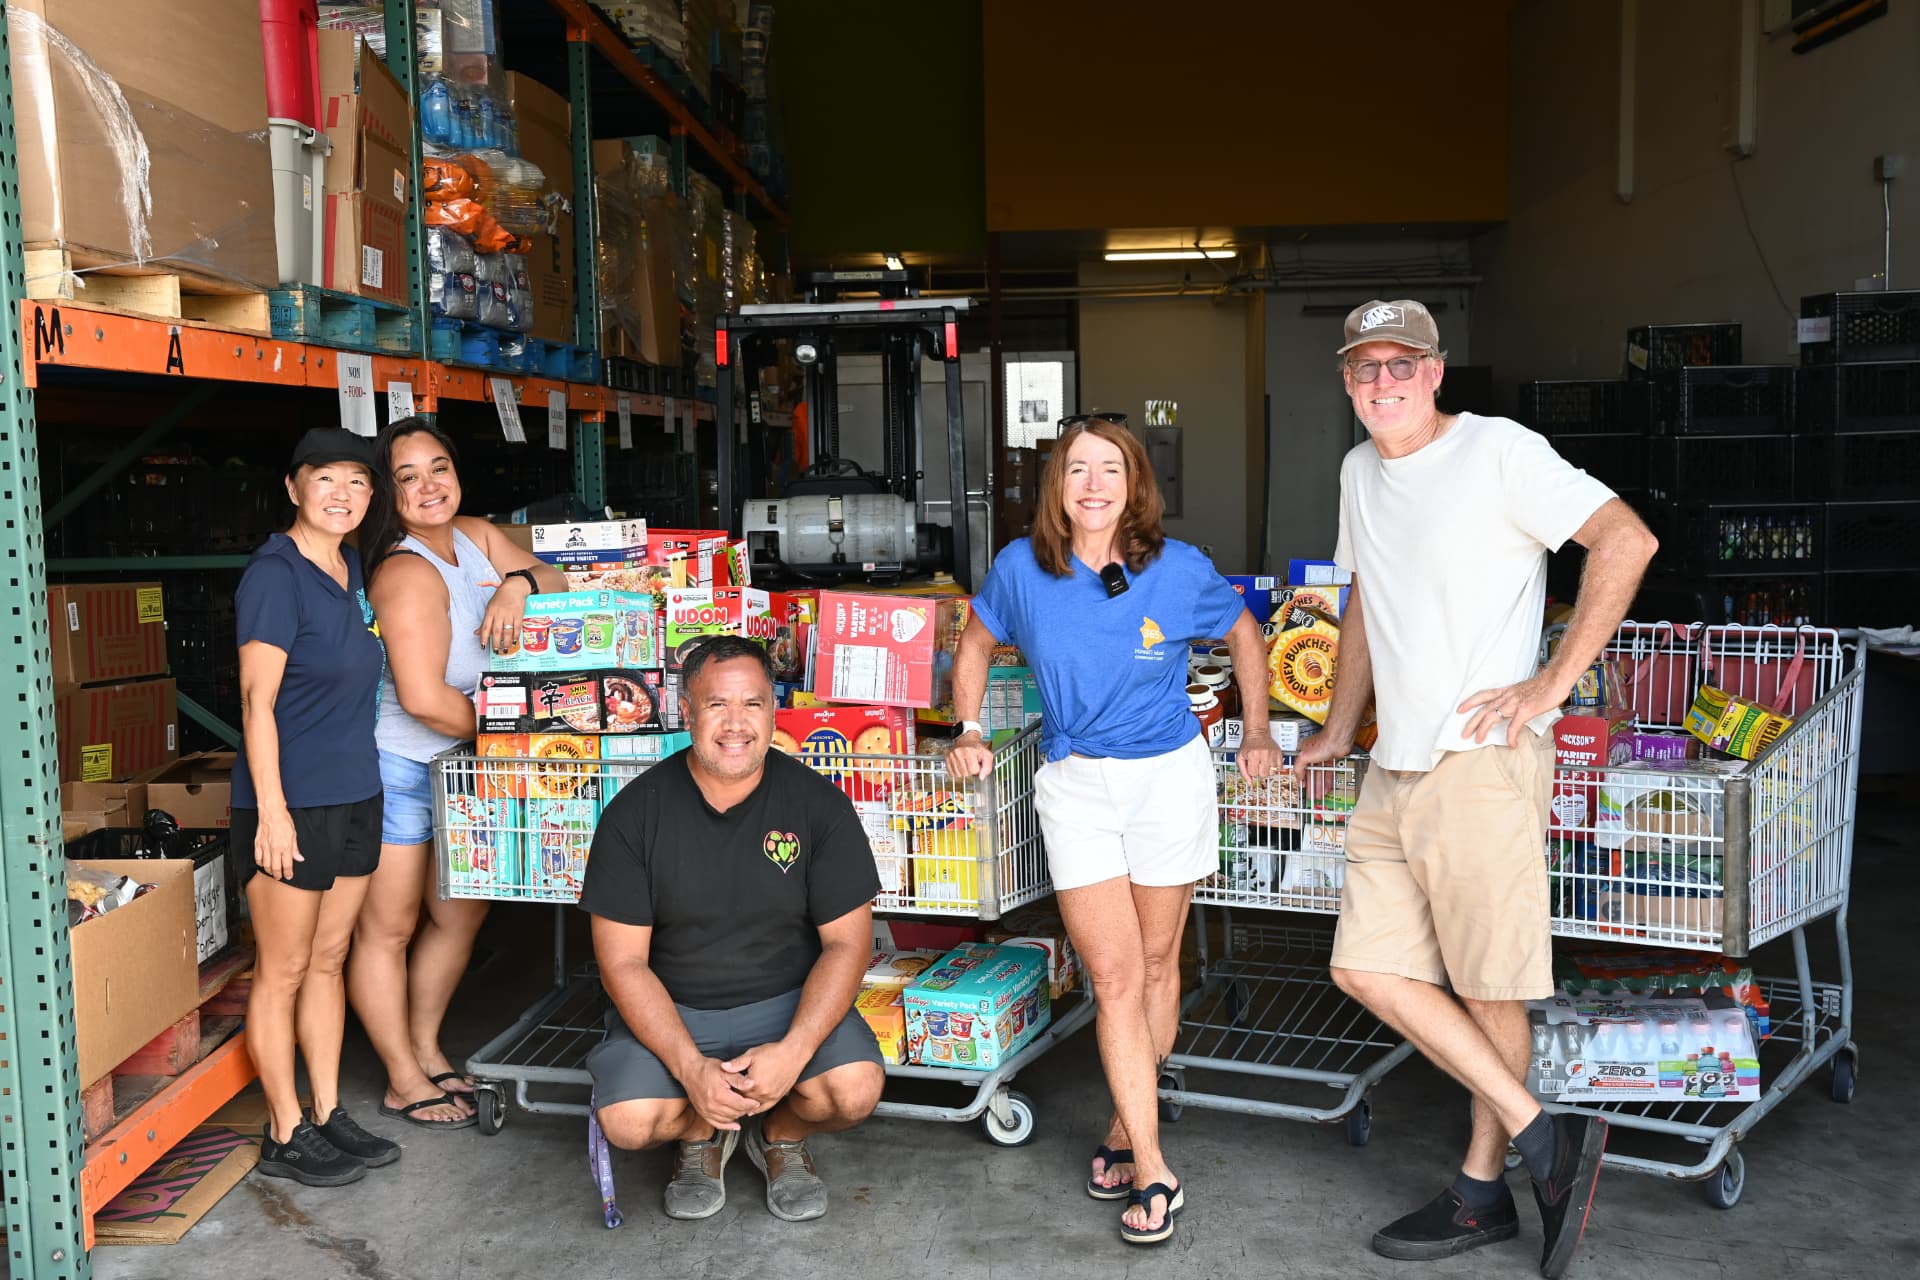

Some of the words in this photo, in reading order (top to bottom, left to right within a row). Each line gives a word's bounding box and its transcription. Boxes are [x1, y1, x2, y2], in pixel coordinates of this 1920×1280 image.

[34, 306, 65, 360] M
[166, 326, 185, 375] A
[348, 366, 361, 379] NON
[534, 527, 545, 540] 52
[529, 599, 567, 611] Variety
[569, 596, 594, 608] Pack
[674, 608, 728, 625] UDON
[850, 601, 860, 638] VARIETY
[858, 608, 867, 632] PACK
[746, 615, 777, 640] UDON
[1286, 638, 1332, 662] BUNCHES
[650, 673, 657, 681] 10
[1283, 662, 1308, 696] HONEY
[1313, 686, 1323, 696] of
[540, 682, 565, 718] 辛
[564, 694, 593, 705] BLACK
[1744, 710, 1758, 731] VALLEY
[1228, 723, 1240, 735] 52
[1560, 734, 1597, 746] JACKSON'S
[801, 738, 852, 778] RITZ
[1556, 749, 1597, 760] VARIETY
[1309, 826, 1345, 843] ONE
[932, 999, 958, 1010] Variety
[959, 1001, 978, 1010] Pack
[1597, 1065, 1646, 1076] ZERO
[1703, 1073, 1716, 1083] G
